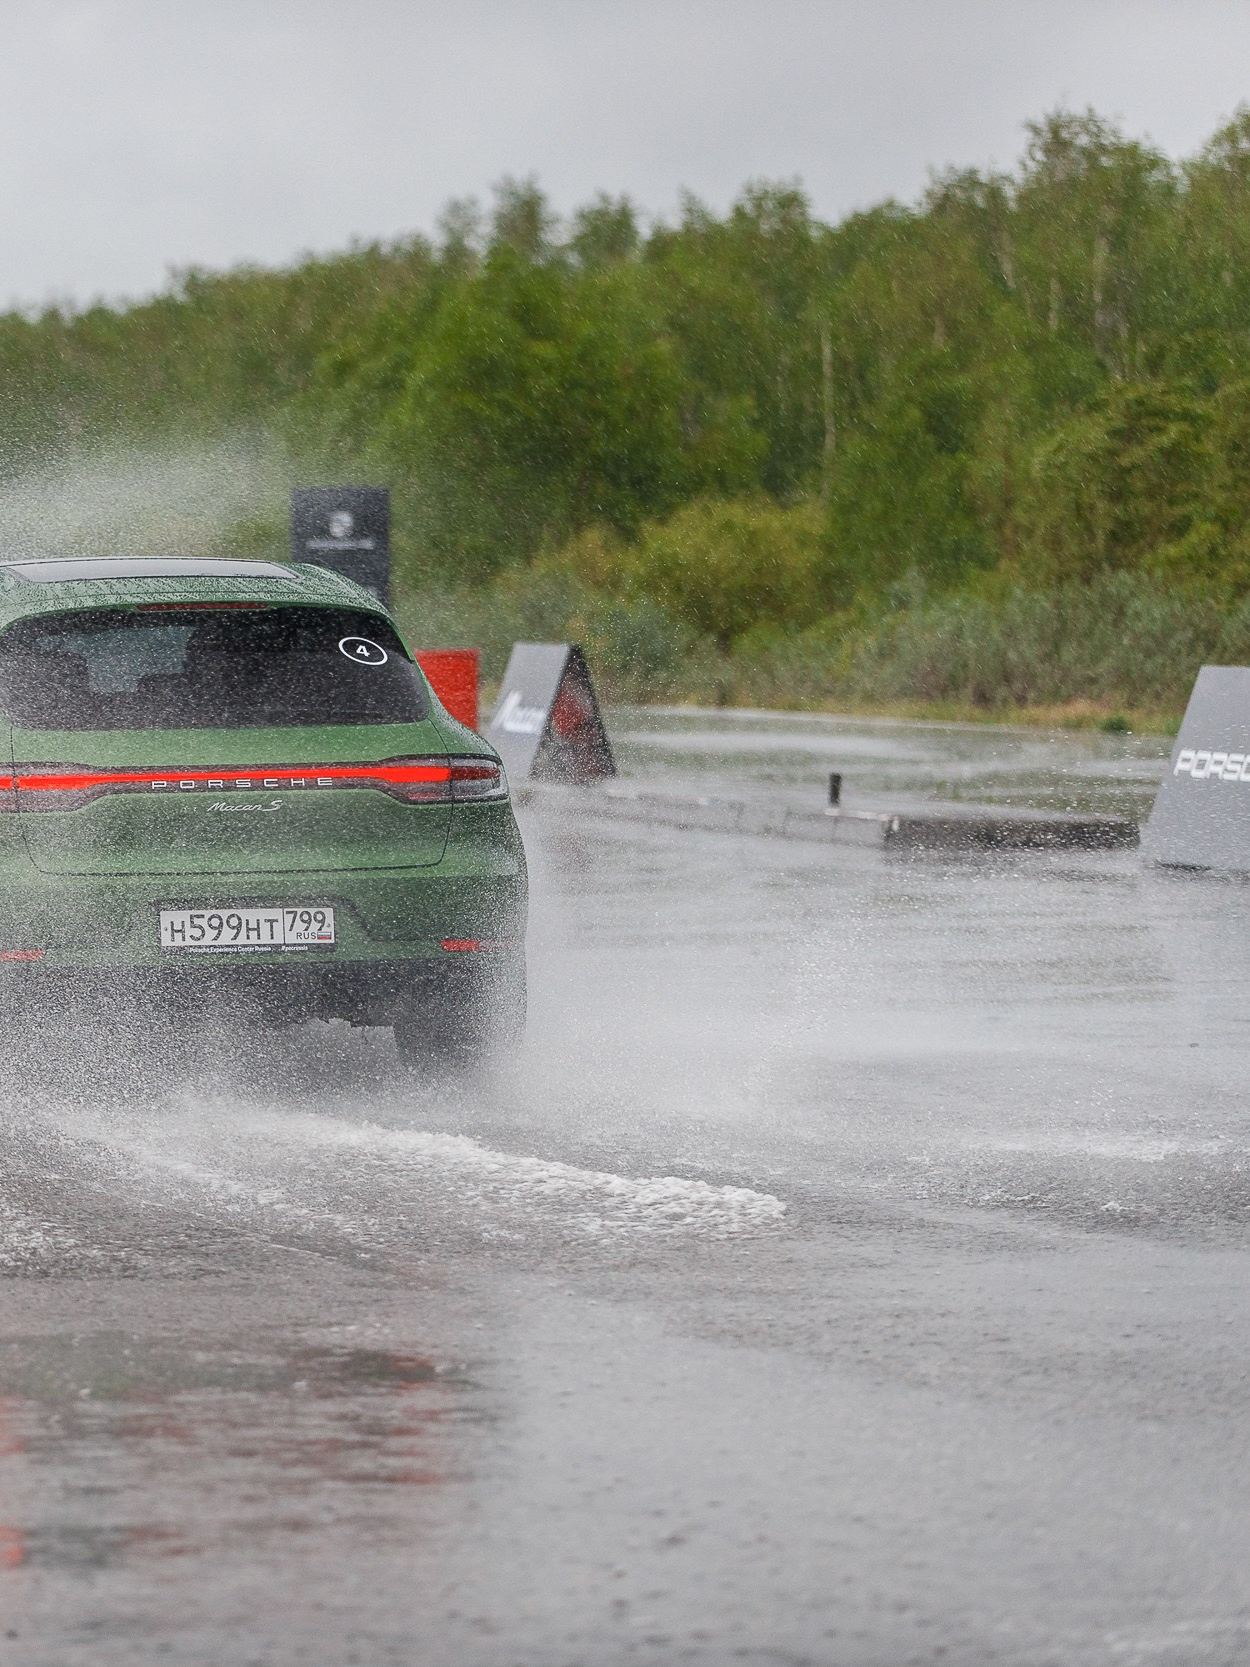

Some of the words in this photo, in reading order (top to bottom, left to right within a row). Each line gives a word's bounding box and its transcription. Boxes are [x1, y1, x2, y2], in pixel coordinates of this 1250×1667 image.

[356, 645, 370, 657] 4
[151, 777, 333, 789] PORSCHE
[207, 802, 263, 812] Macan
[262, 799, 283, 812] S
[285, 910, 326, 932] 799
[296, 932, 316, 940] RUS
